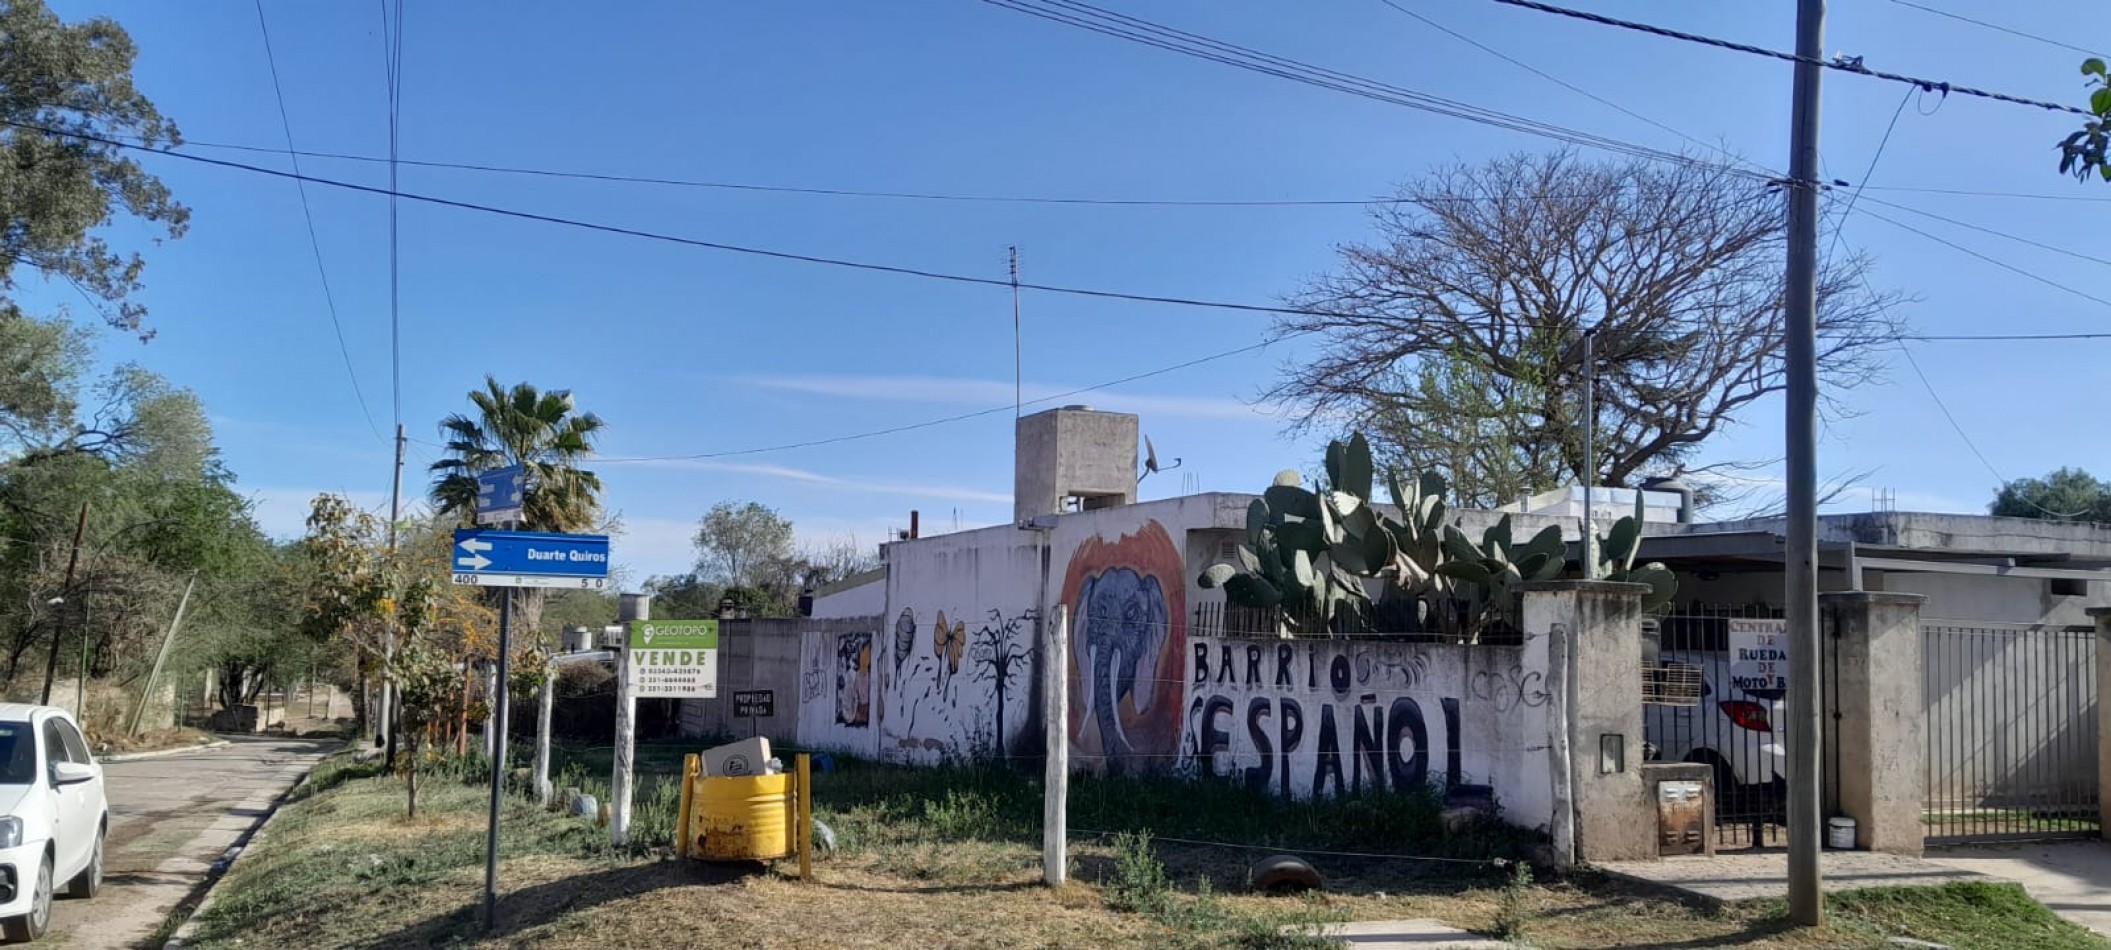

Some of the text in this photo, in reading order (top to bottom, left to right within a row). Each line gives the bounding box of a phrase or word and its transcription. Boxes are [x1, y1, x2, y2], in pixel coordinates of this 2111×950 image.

[527, 548, 606, 563] Duarte Quiros
[454, 574, 478, 585] 400
[1757, 634, 1775, 645] DE
[634, 651, 707, 666] VENDE
[1758, 661, 1776, 673] DE
[1732, 675, 1767, 688] MOTO
[1200, 694, 1493, 807] ESPAÑOL
